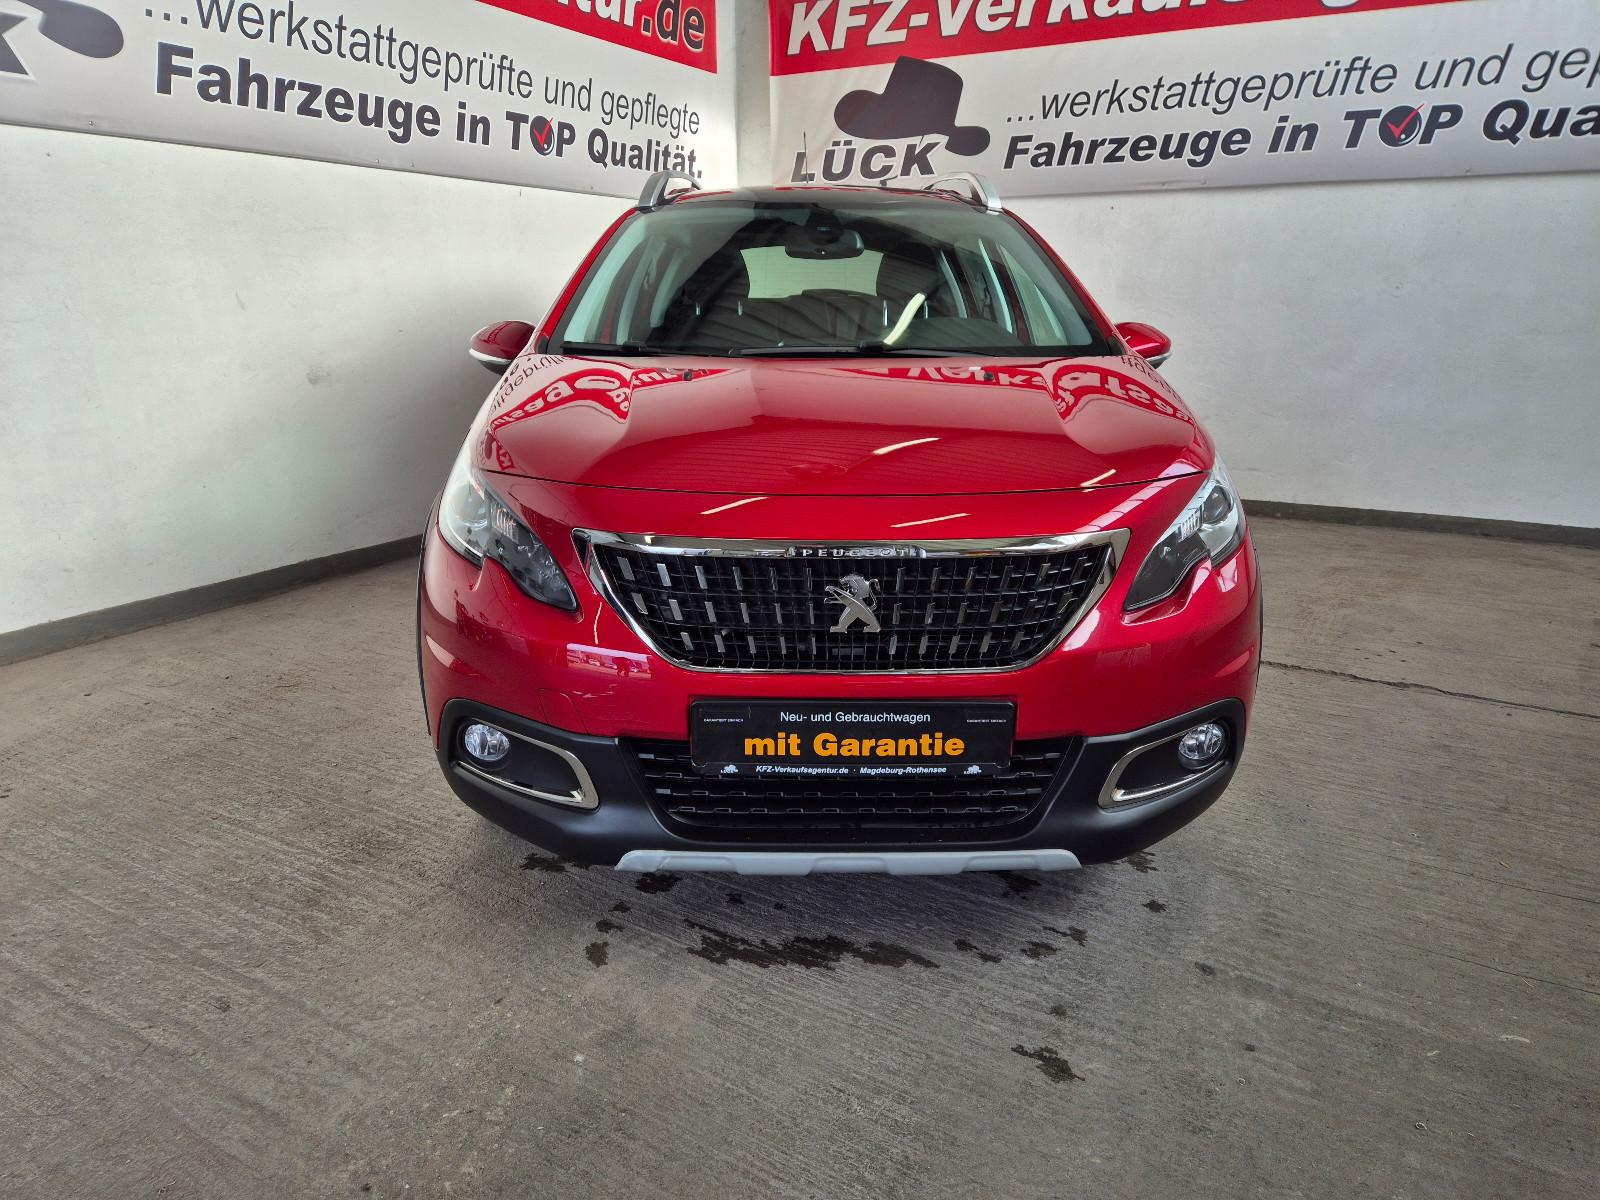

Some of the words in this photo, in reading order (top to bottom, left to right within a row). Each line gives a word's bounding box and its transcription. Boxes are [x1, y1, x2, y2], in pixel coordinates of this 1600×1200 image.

[1006, 55, 1398, 122] ...werkstattgeprüfte
[1415, 42, 1514, 90] und
[156, 41, 441, 144] Fahrzeuge
[456, 100, 491, 146] in
[588, 127, 703, 179] Qualität.
[544, 77, 593, 112] und
[601, 88, 700, 139] gepflegte
[791, 140, 941, 183] LÜCK
[1003, 126, 1252, 170] Fahrzeuge
[1267, 115, 1319, 154] in
[802, 548, 908, 557] PEUGEOT
[780, 712, 808, 723] Neu-
[812, 712, 832, 723] und
[835, 712, 931, 725] Gebrauchtwagen
[744, 732, 801, 756] mit
[813, 732, 965, 757] Garantie
[755, 765, 849, 775] KFZ-Verkaufsagentur.de
[859, 766, 947, 776] Magdeburg-Rothensee
